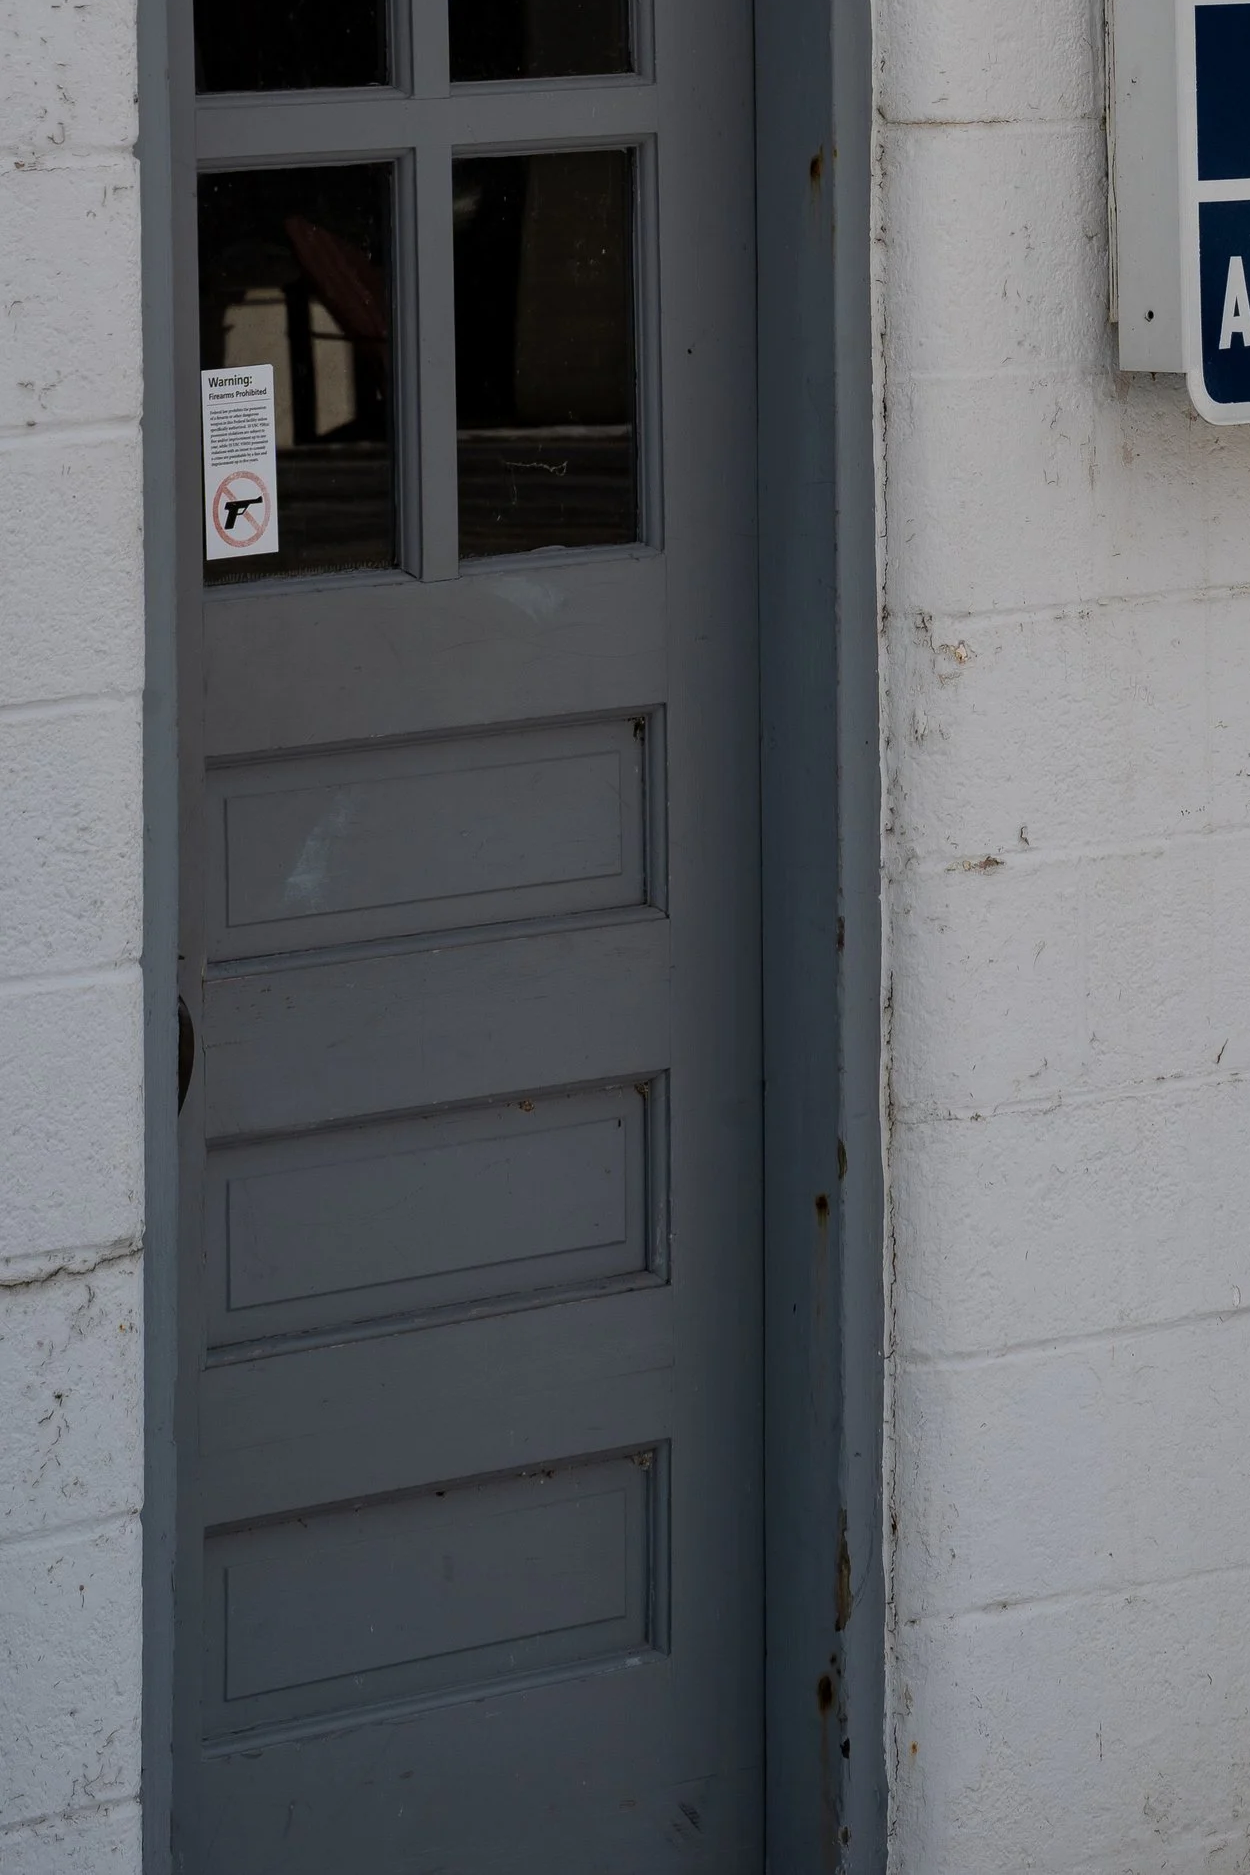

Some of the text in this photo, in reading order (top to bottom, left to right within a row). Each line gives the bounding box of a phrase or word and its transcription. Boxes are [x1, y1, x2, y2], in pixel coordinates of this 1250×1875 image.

[208, 375, 253, 388] Warning:
[208, 388, 267, 401] Firearms Prohibited
